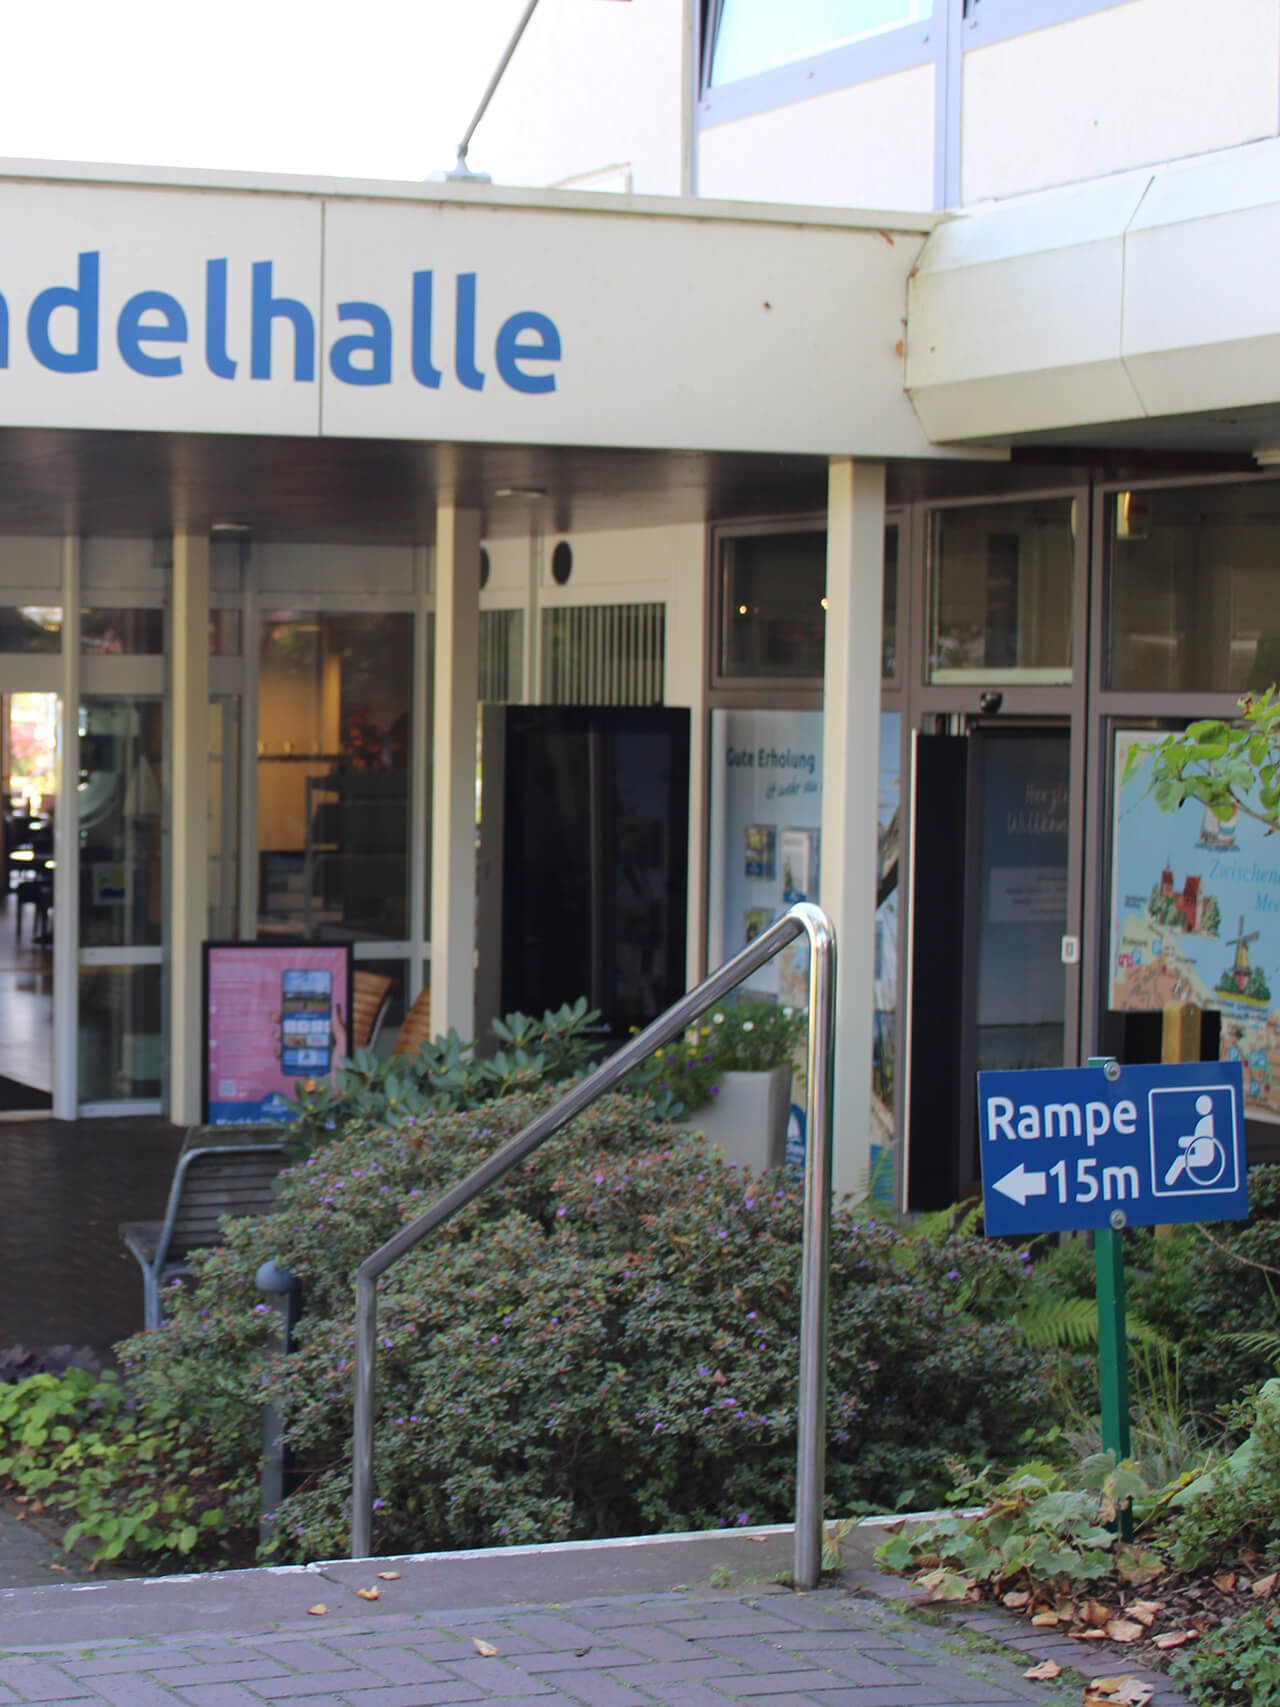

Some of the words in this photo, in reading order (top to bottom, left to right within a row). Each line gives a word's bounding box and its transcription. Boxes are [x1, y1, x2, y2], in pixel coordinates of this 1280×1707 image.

[726, 747, 755, 768] Gute
[758, 747, 816, 774] Erholung
[987, 1096, 1137, 1147] Rampe
[1049, 1158, 1140, 1204] 15m
